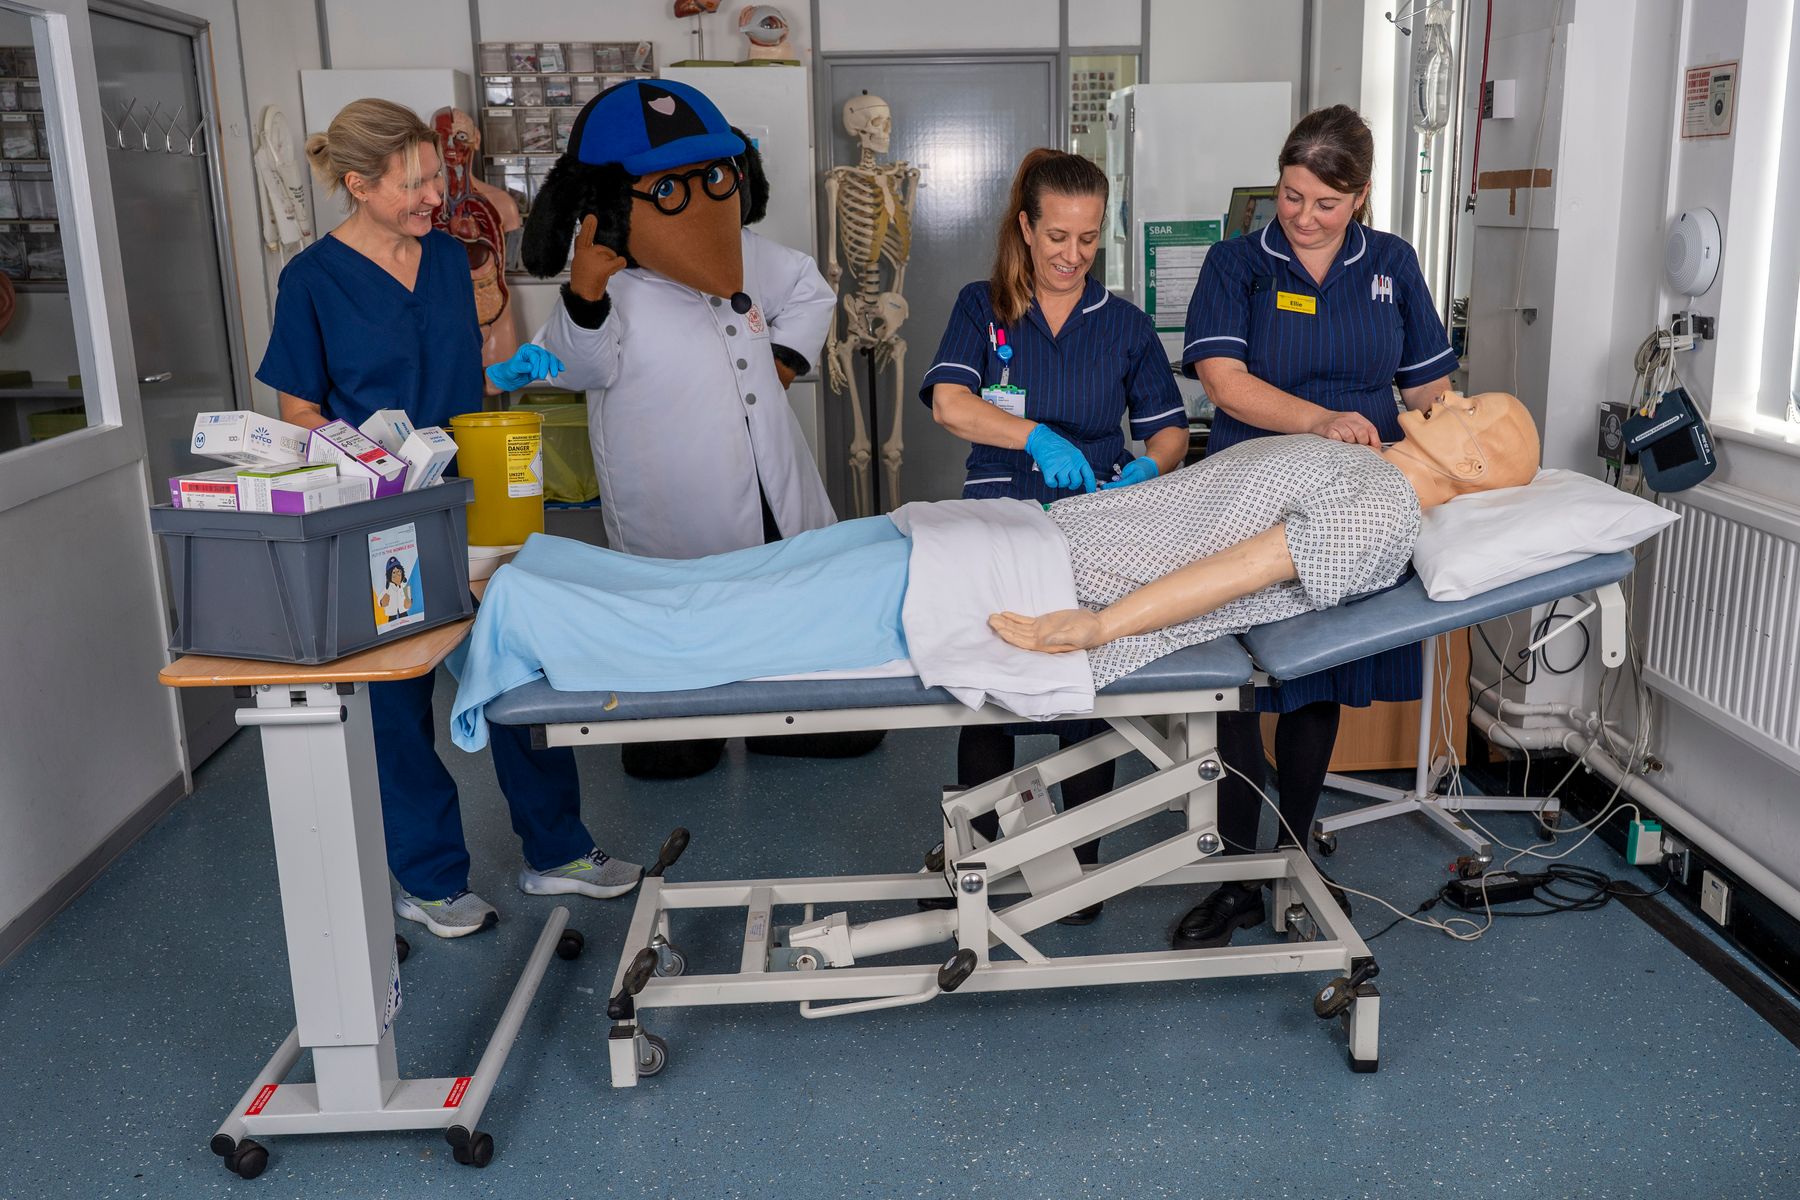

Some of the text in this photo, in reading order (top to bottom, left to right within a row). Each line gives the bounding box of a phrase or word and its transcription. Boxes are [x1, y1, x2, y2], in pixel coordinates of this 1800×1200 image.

[1149, 225, 1173, 235] SBAR
[1149, 247, 1155, 256] S
[1149, 269, 1155, 277] B
[1149, 280, 1156, 288] A
[250, 433, 272, 444] INTCO
